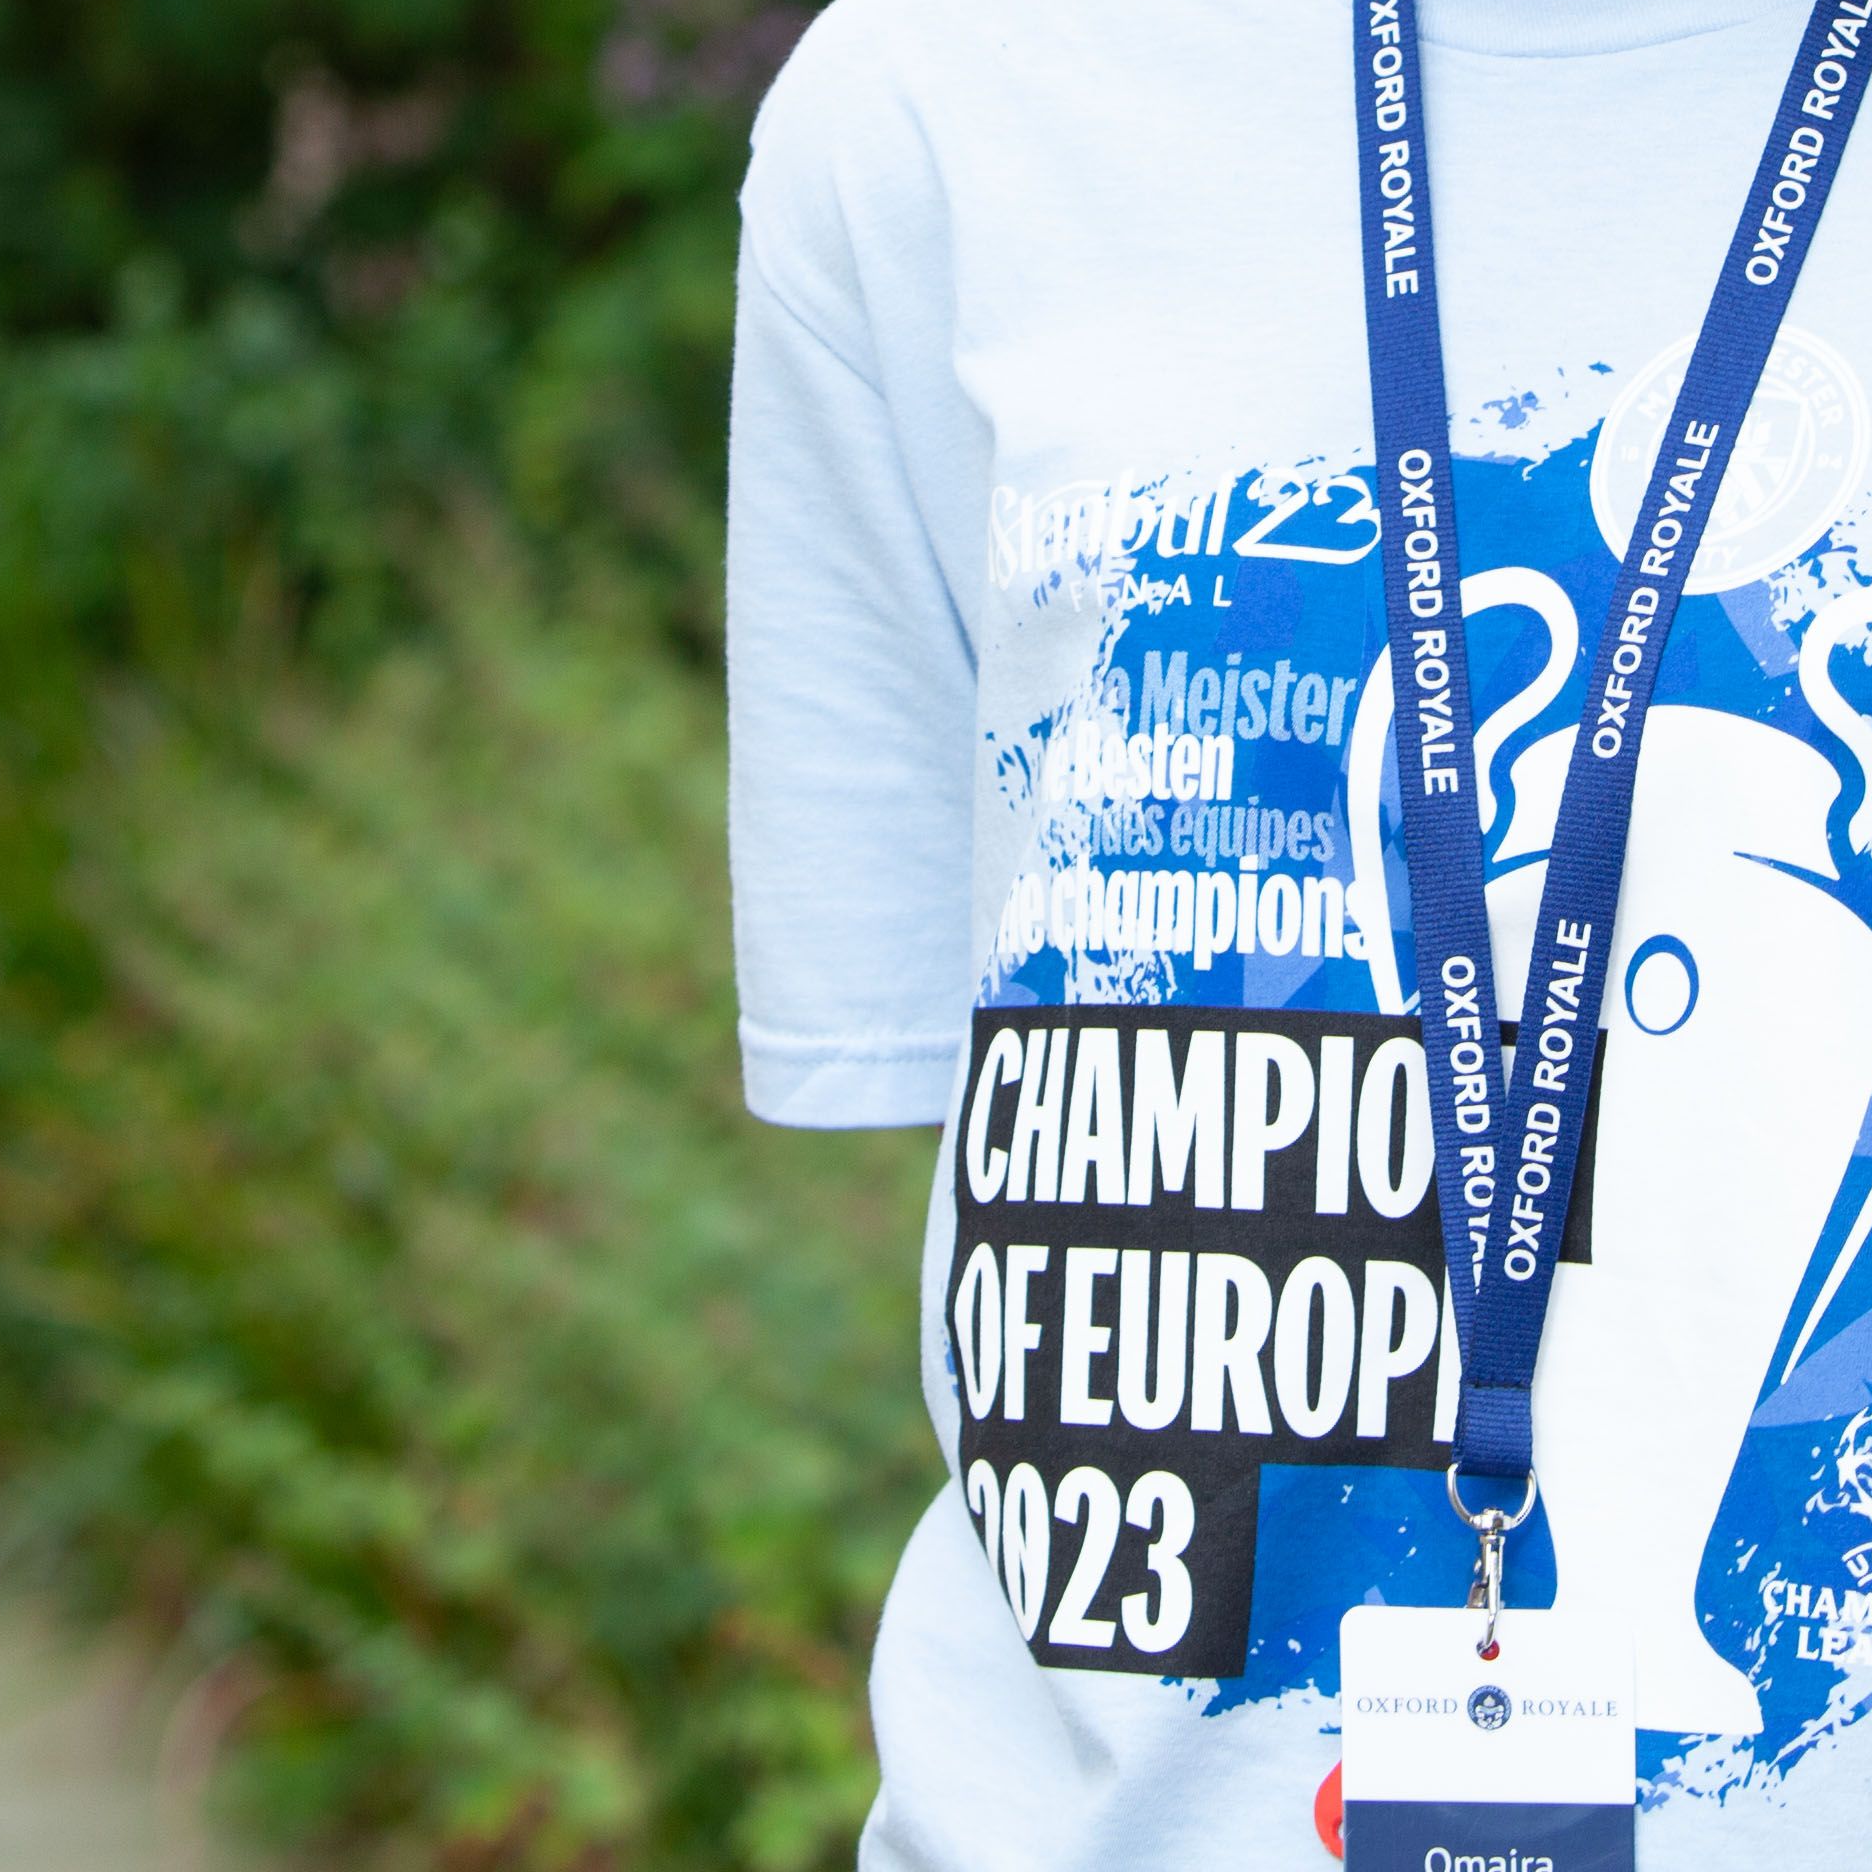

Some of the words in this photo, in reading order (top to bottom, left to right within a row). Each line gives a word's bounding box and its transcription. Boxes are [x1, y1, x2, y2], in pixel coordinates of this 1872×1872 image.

[1379, 140, 1418, 298] ROYALE
[1745, 127, 1824, 285] OXFORD
[1636, 344, 1844, 430] MAESTER
[1399, 449, 1443, 617] OXFORD
[1592, 587, 1659, 758] OXFORD
[1640, 421, 1719, 576] ROYALE
[1073, 721, 1235, 801] Besten
[1139, 650, 1358, 746] Meister
[1413, 630, 1458, 795] ROYALE
[965, 1027, 1436, 1220] CHAMPIO
[1442, 956, 1490, 1133] OXFORD
[1504, 1103, 1560, 1280] OXFORD
[1533, 919, 1591, 1091] ROYALE
[954, 1242, 1050, 1422] OF
[967, 1458, 1196, 1655] 2023
[1356, 1696, 1459, 1716] OXFORD
[1522, 1699, 1618, 1718] ROYALE
[1424, 1846, 1553, 1872] Omaira
